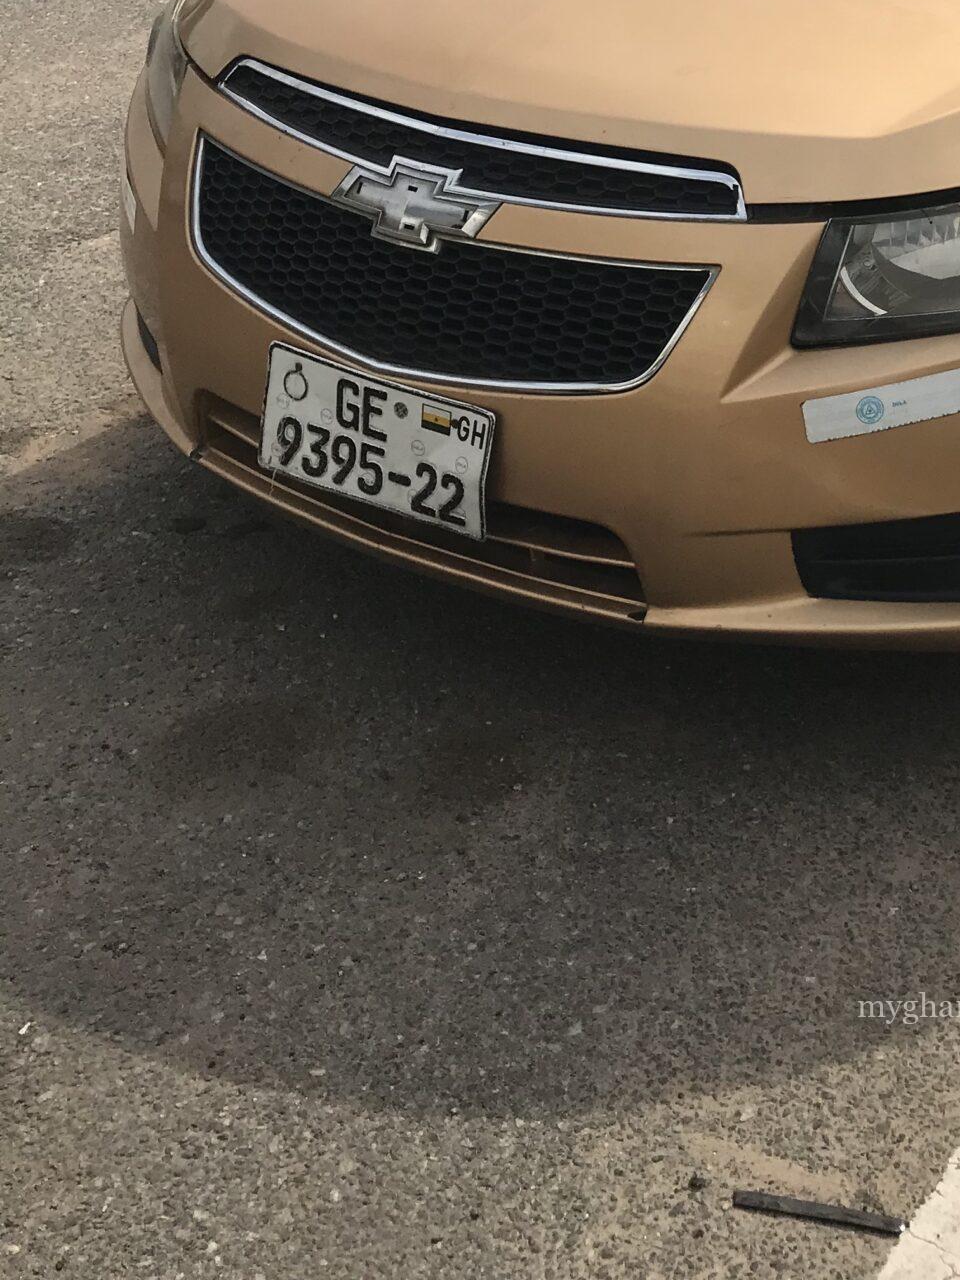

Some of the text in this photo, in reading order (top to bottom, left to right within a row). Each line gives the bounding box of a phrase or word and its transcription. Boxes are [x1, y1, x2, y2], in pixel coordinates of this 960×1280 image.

[336, 378, 487, 450] GE GH
[277, 416, 467, 527] 9395-22
